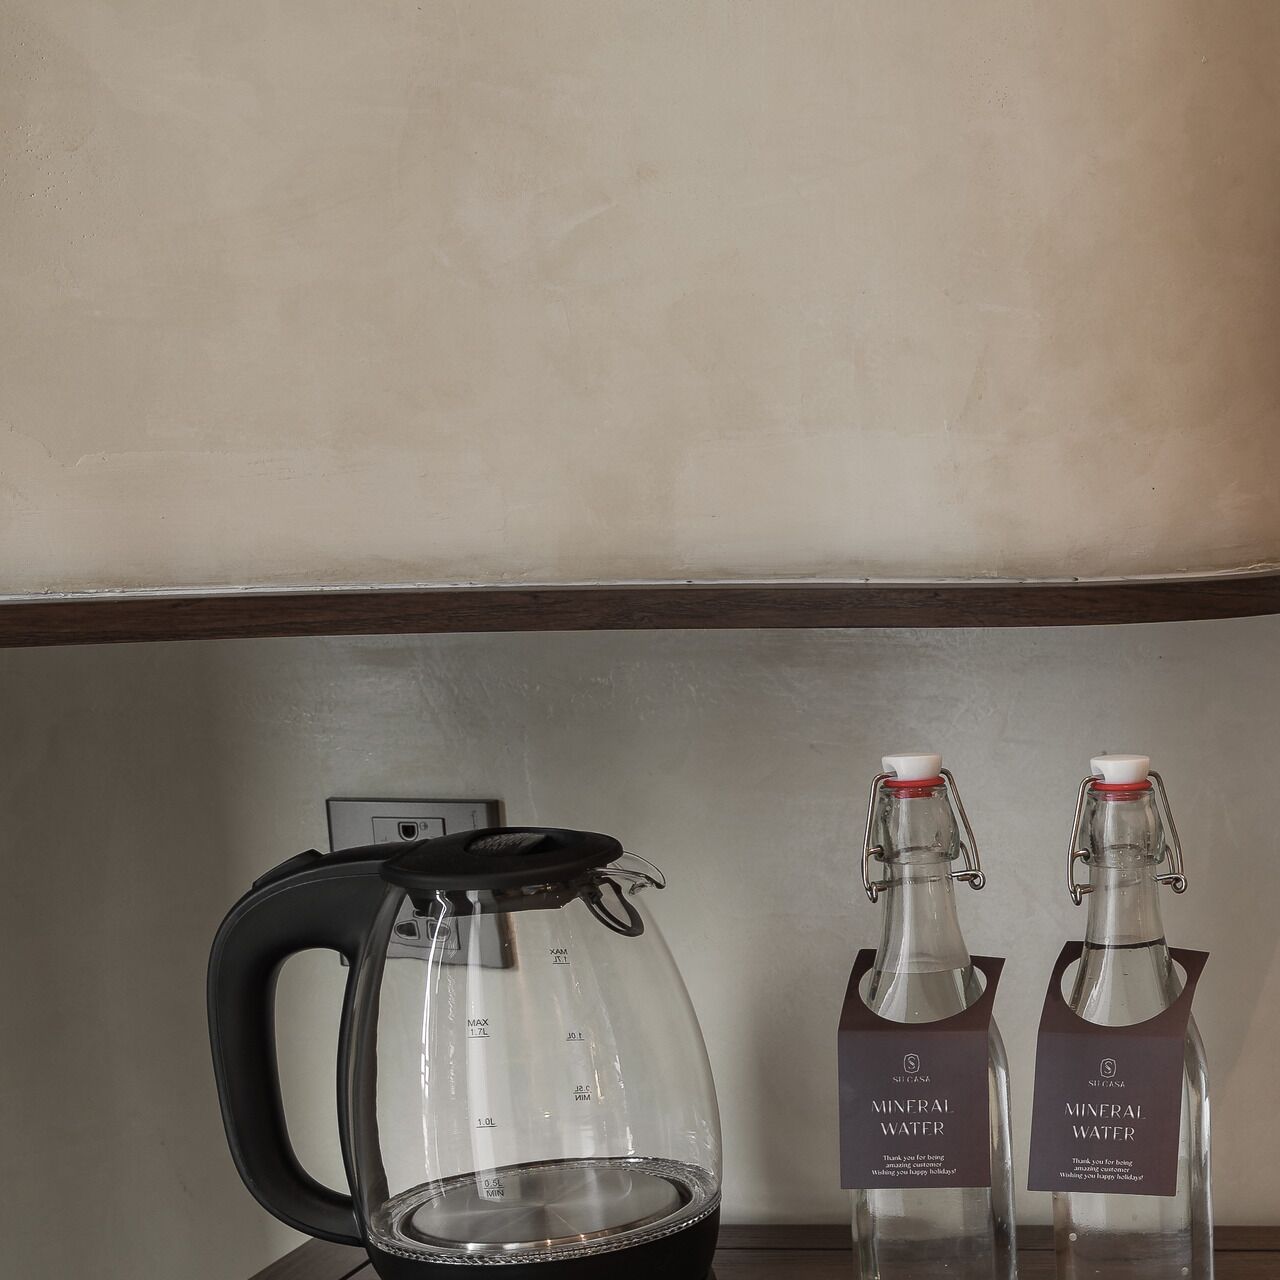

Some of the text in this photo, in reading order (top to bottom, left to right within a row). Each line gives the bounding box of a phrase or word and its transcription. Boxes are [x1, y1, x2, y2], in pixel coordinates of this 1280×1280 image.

[467, 1018, 489, 1027] MAX
[470, 1028, 488, 1036] 1.7L
[871, 1099, 955, 1114] MINERAL
[1064, 1102, 1147, 1120] MINERAL
[477, 1117, 496, 1126] 1.0L
[880, 1121, 945, 1136] WATER
[1072, 1125, 1135, 1141] WATER
[1115, 1159, 1133, 1167] being
[929, 1168, 957, 1176] holidays!
[484, 1179, 503, 1187] 0.5L
